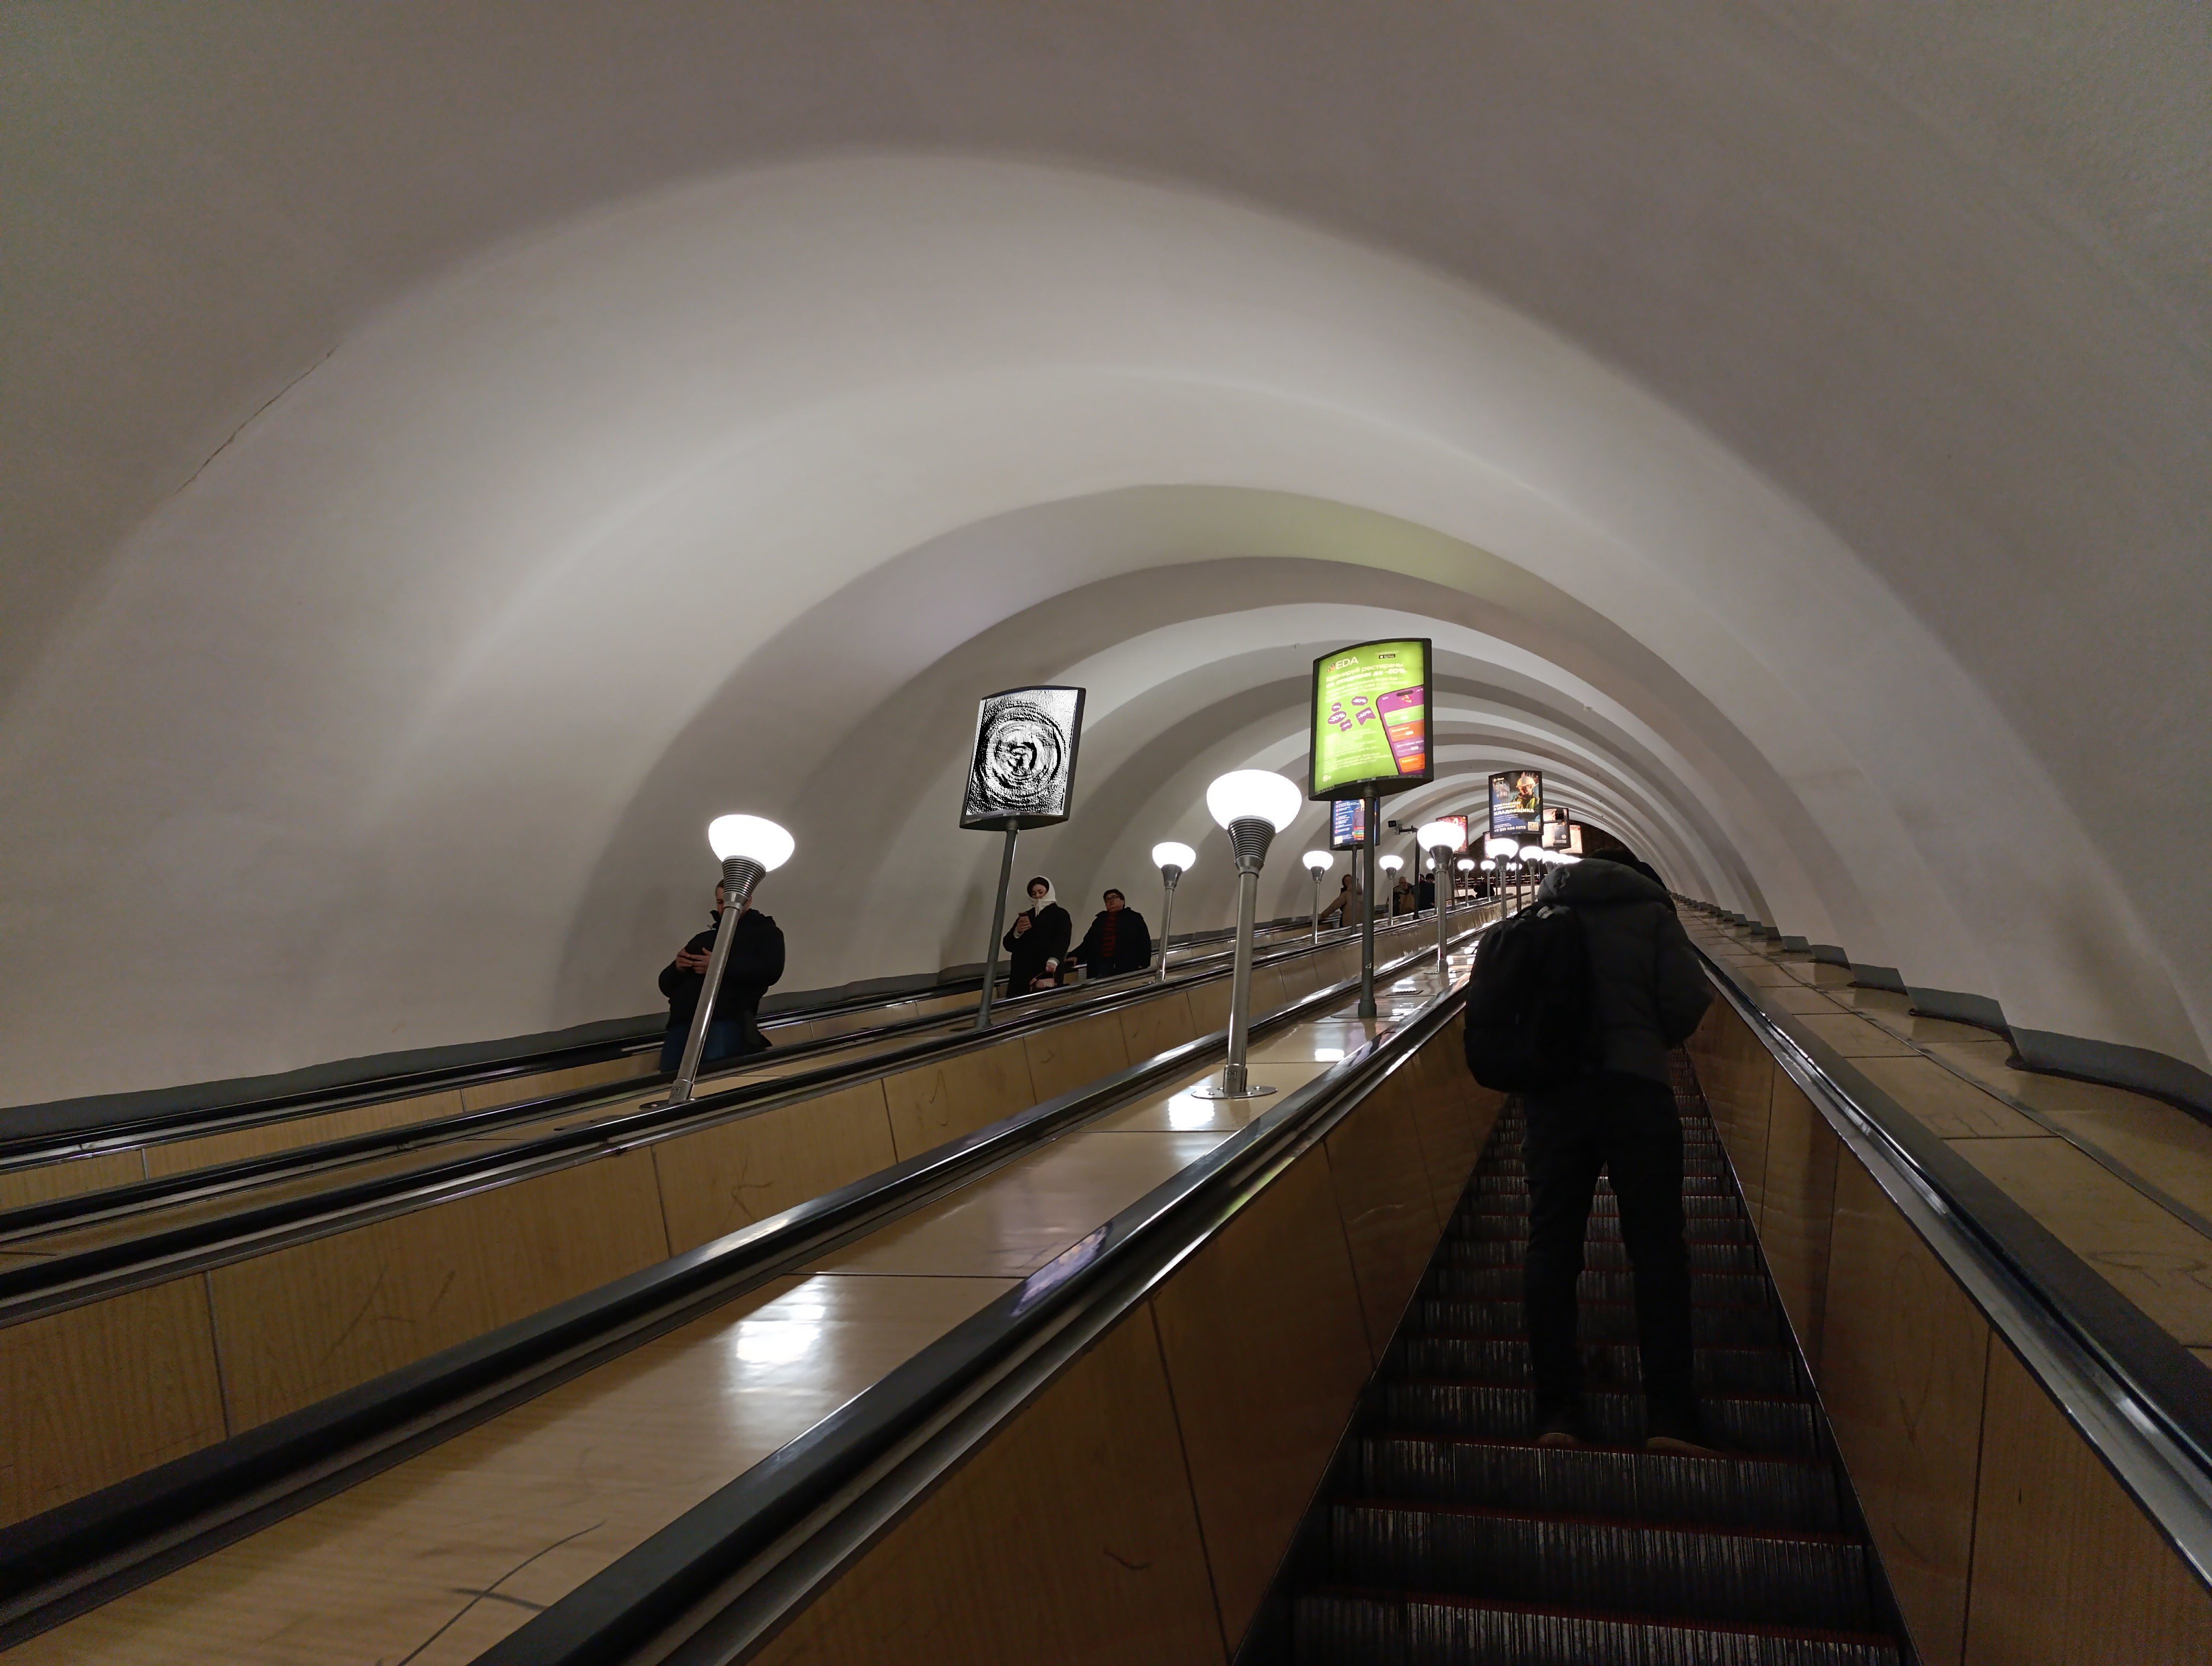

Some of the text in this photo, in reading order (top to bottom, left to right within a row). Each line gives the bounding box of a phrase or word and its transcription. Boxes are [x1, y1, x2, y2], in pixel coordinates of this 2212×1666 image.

[1335, 657, 1359, 670] EDA
[1361, 663, 1404, 672] рестораны
[1227, 1069, 1238, 1081] 11
